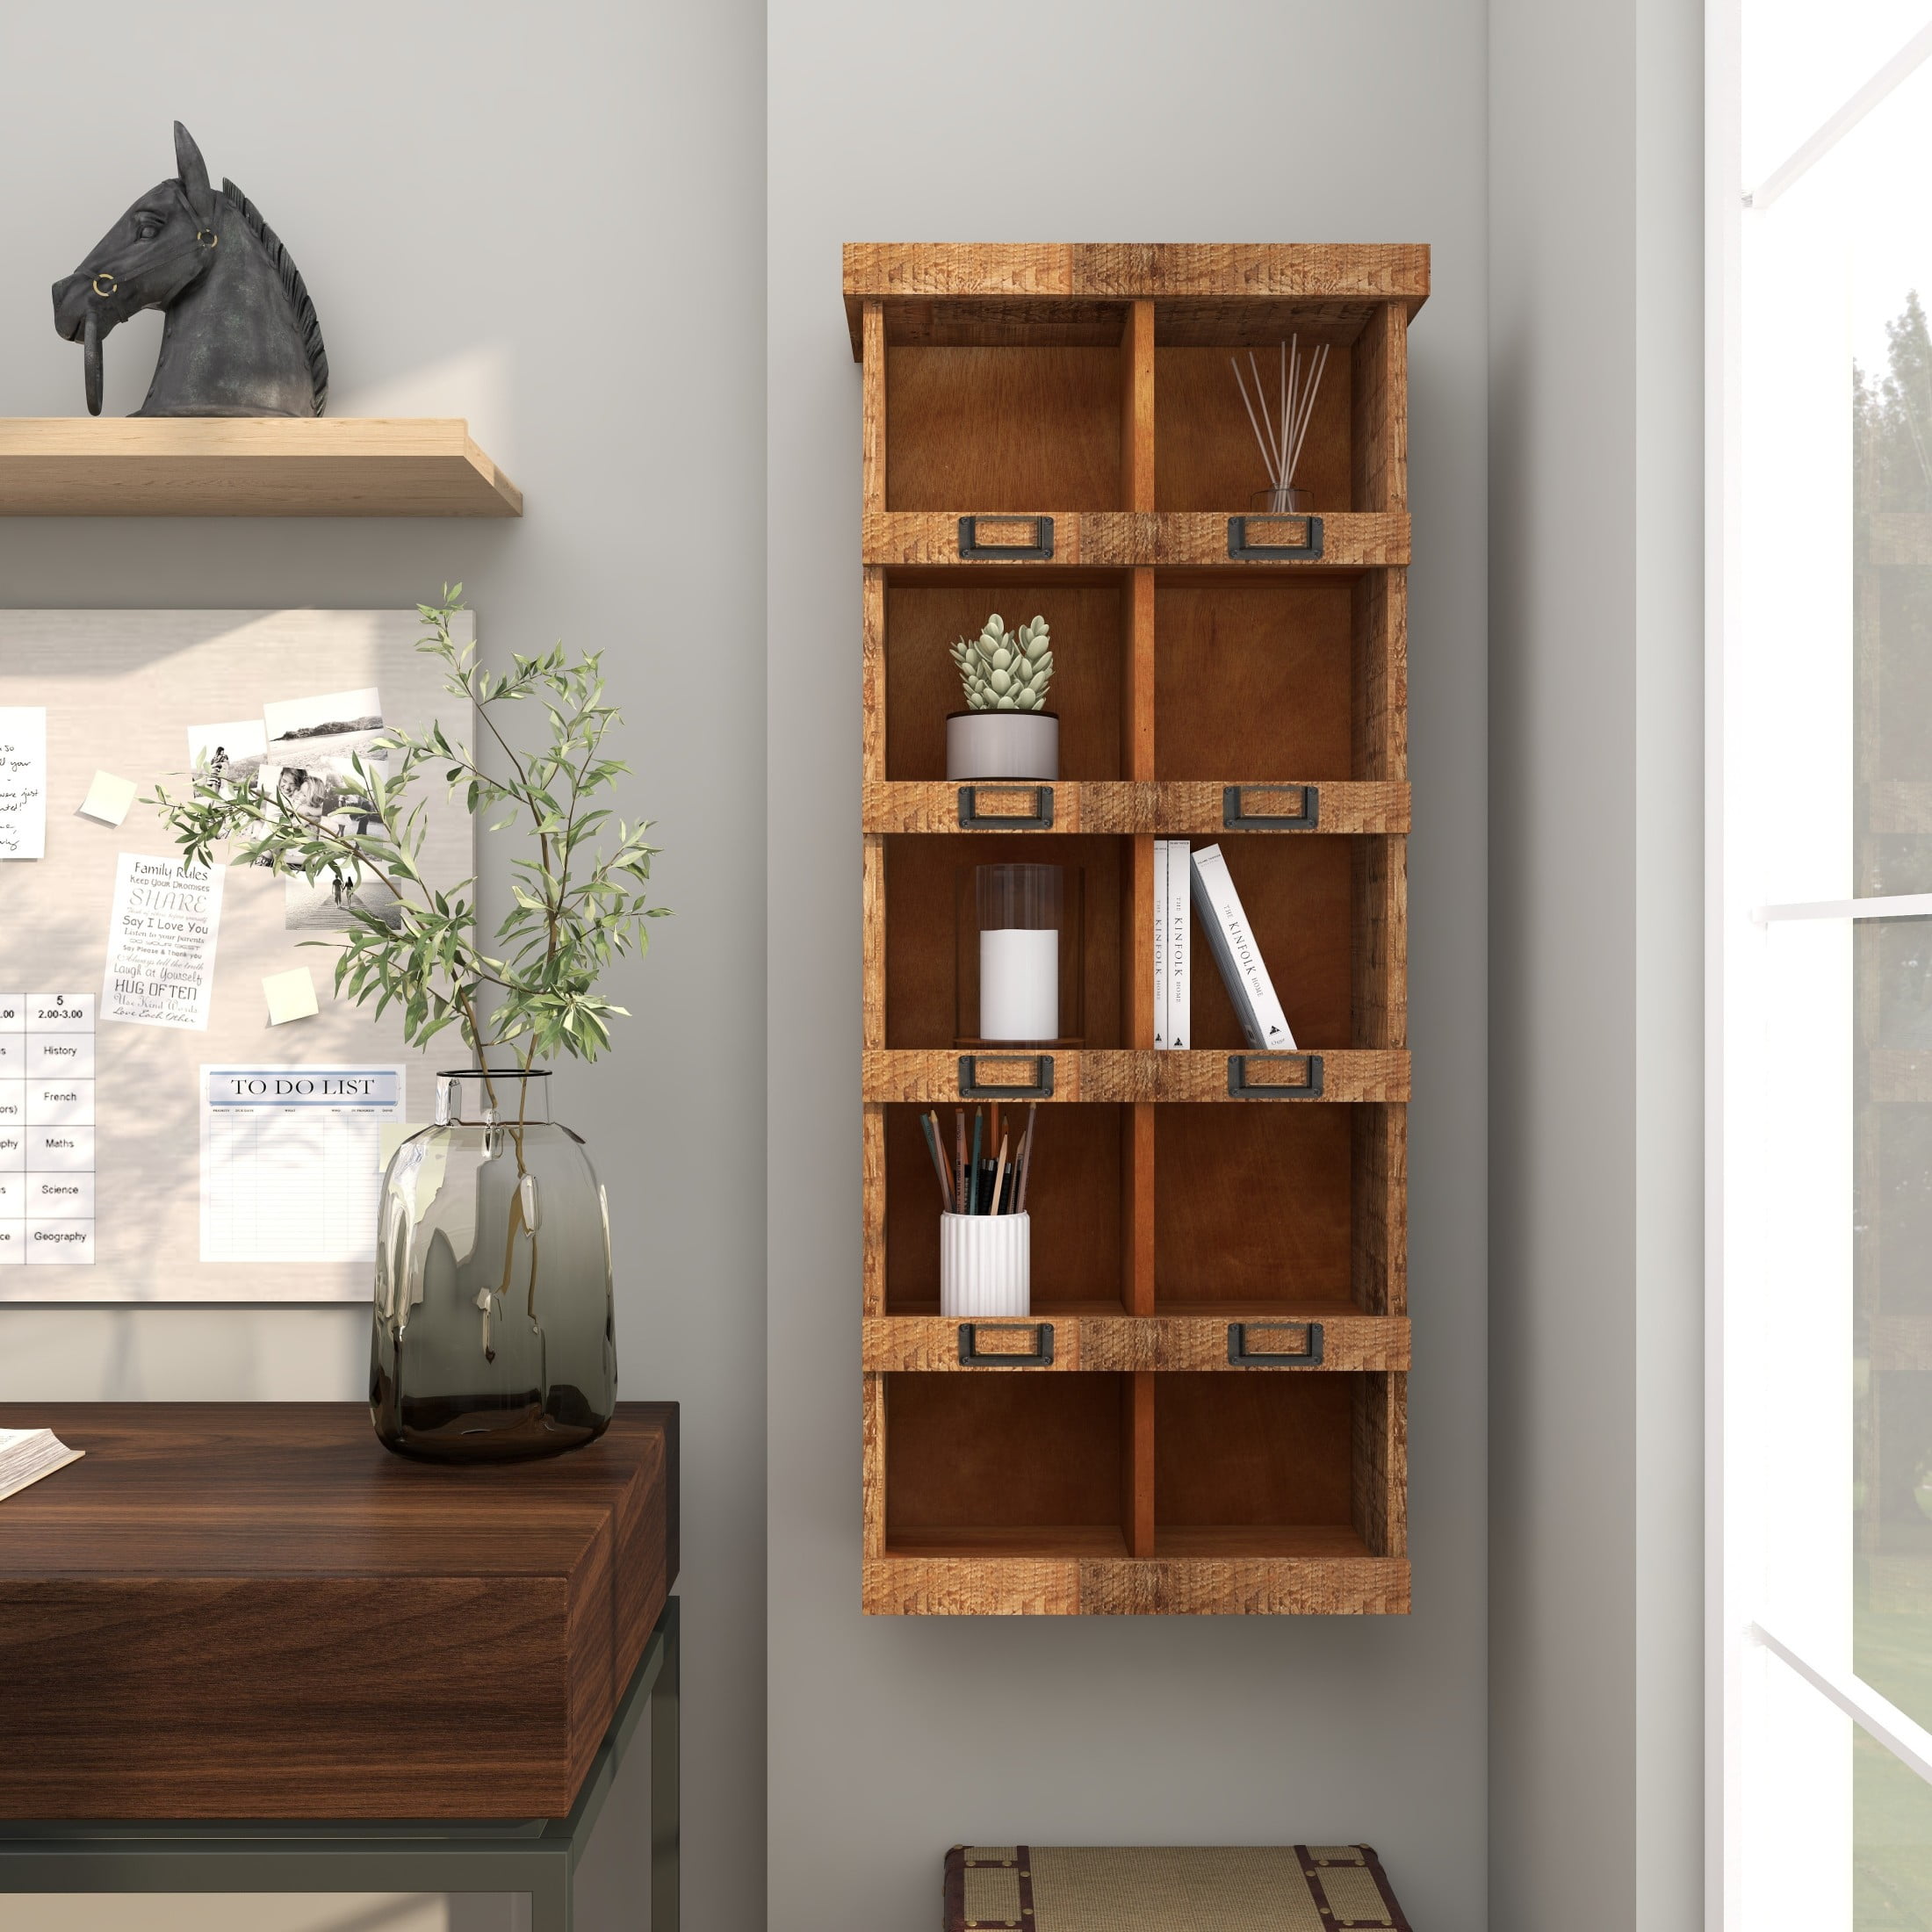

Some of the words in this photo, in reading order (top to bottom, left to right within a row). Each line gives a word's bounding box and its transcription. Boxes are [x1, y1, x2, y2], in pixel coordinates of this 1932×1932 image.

[21, 787, 39, 804] just
[134, 861, 172, 880] Family
[176, 866, 208, 881] Rules
[129, 888, 206, 913] SHARE
[122, 915, 144, 929] Say
[148, 917, 155, 927] I
[158, 919, 184, 931] Love
[188, 922, 209, 934] You
[124, 927, 147, 937] Listen
[177, 934, 205, 943] parents
[1223, 905, 1234, 919] THE
[1229, 921, 1257, 975] KINFOLK
[1251, 977, 1264, 998] HOME
[114, 962, 141, 978] Laugh
[145, 968, 156, 978] at
[114, 978, 144, 995] HUG
[148, 983, 197, 1000] OFTEN
[56, 995, 64, 1006] 5
[38, 1010, 83, 1019] 2.00-3.00
[44, 1046, 77, 1056] History
[231, 1079, 267, 1095] TO
[275, 1079, 314, 1095] DO
[321, 1079, 375, 1095] LIST
[44, 1092, 77, 1101] French
[0, 1139, 18, 1150] phy
[46, 1138, 75, 1149] Maths
[41, 1185, 79, 1194] Science
[33, 1231, 86, 1243] Geography
